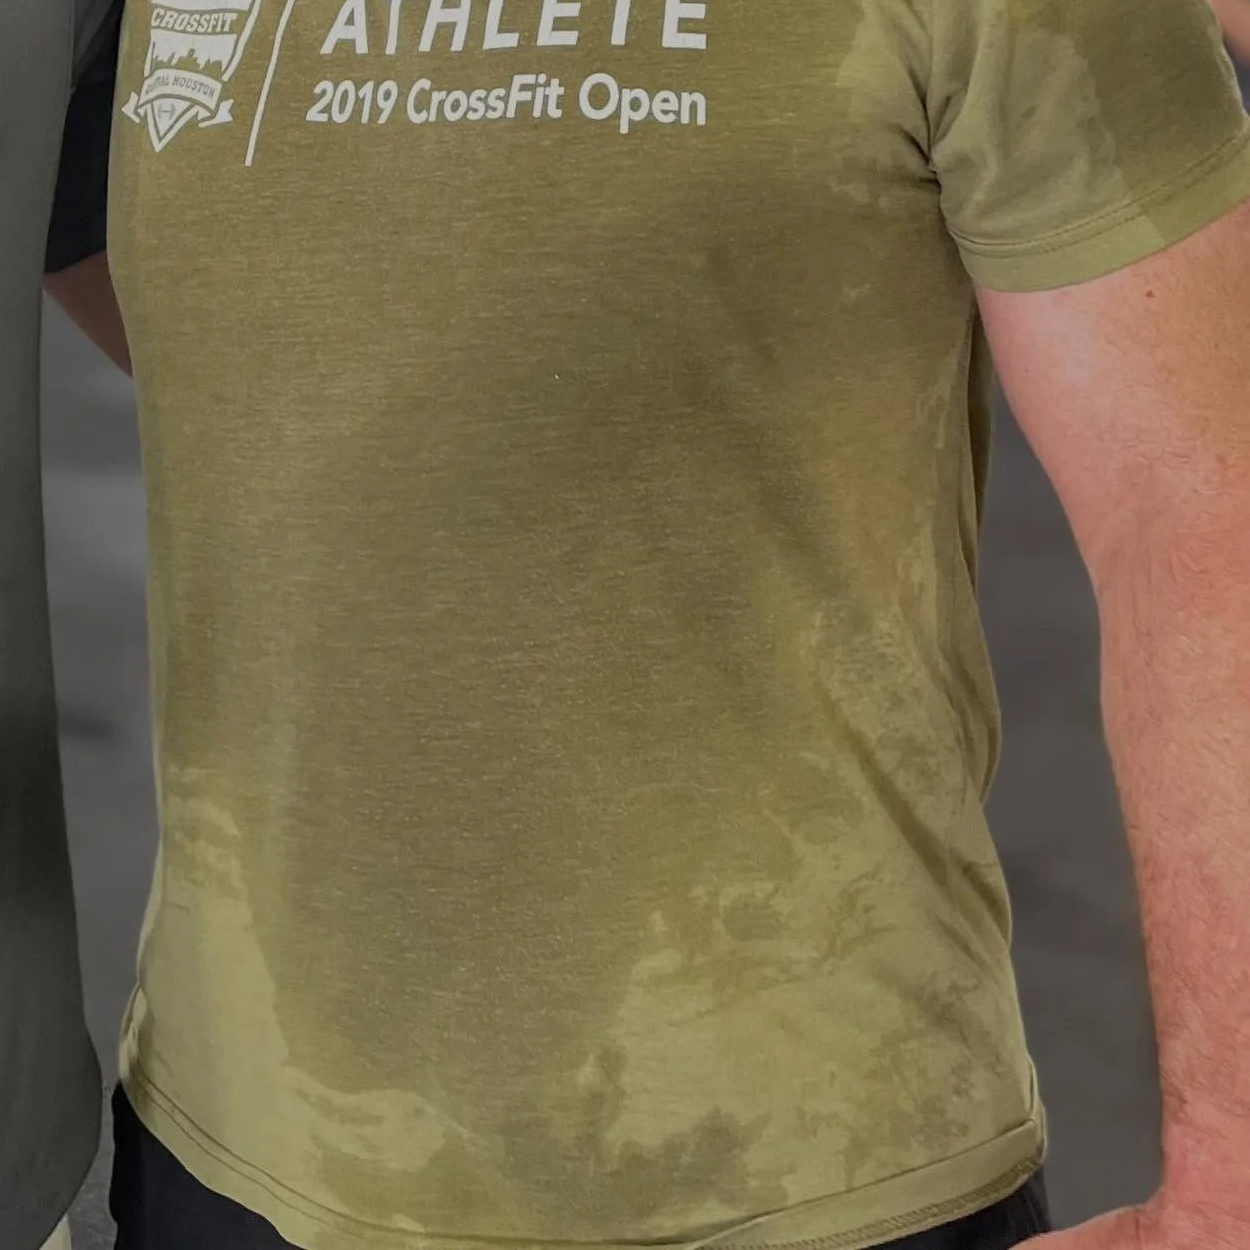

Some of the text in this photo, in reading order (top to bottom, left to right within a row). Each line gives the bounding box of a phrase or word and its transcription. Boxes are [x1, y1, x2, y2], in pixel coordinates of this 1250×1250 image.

[151, 7, 238, 34] CROSSFIT
[172, 75, 216, 99] HOUSTON
[305, 72, 706, 134] 2019 CrossFit Open
